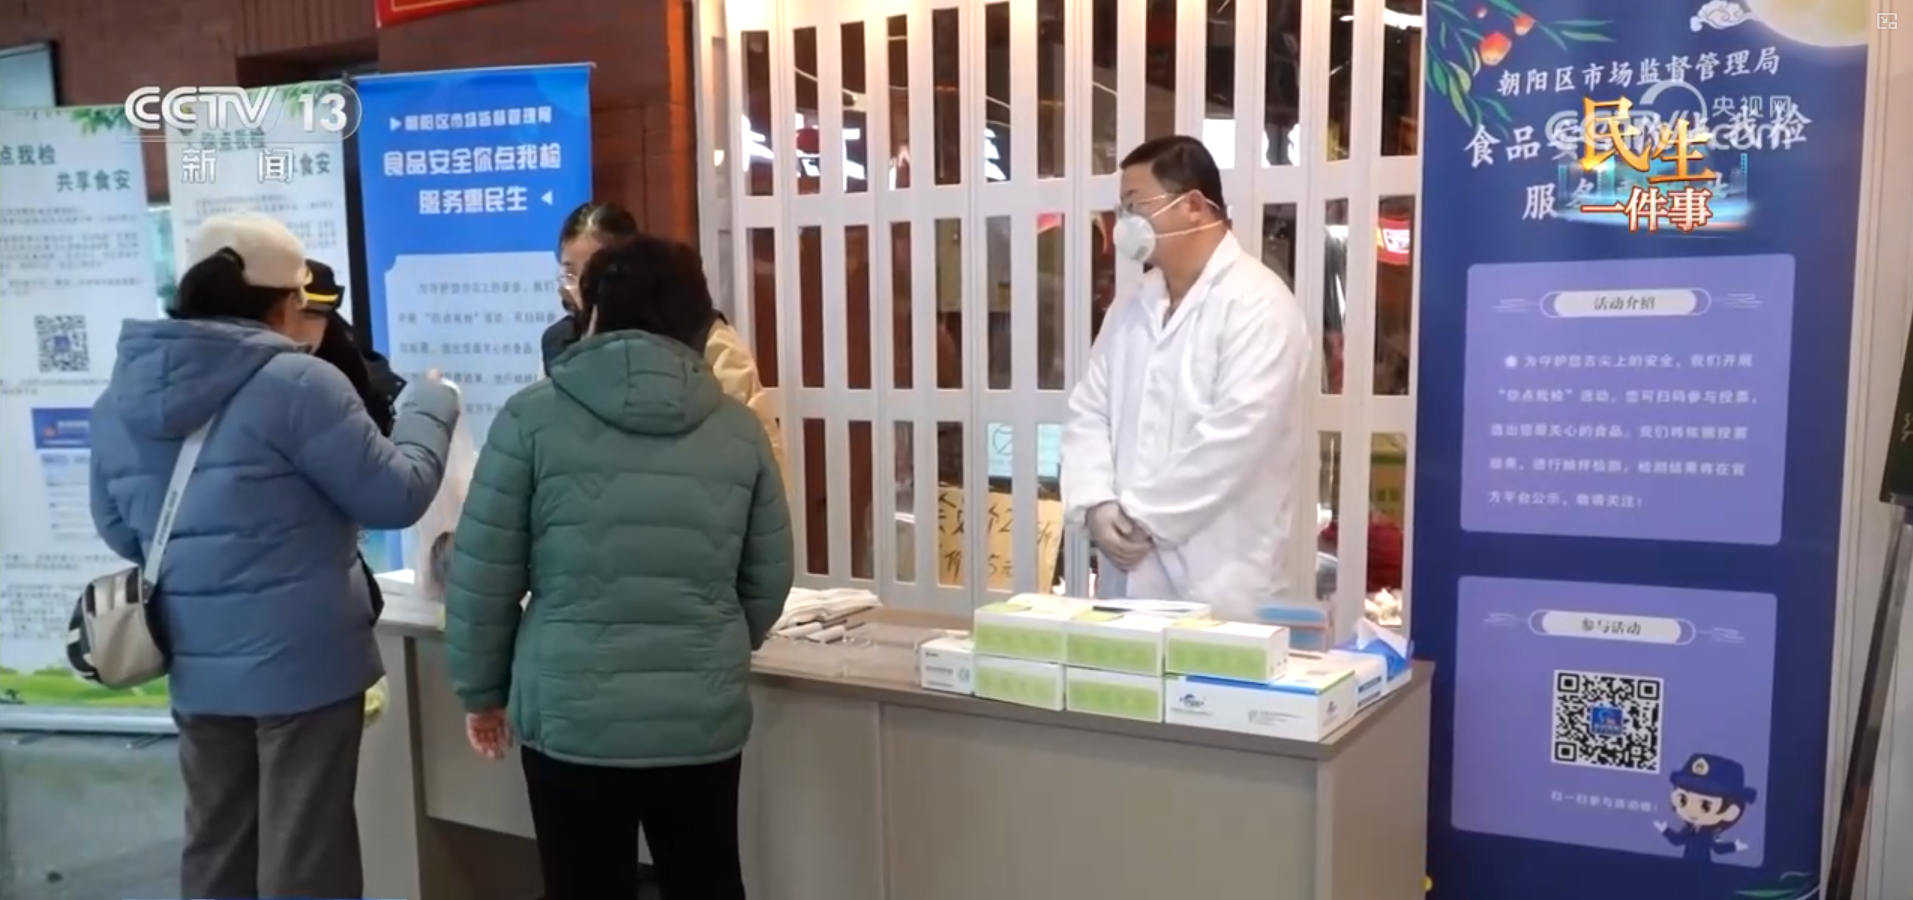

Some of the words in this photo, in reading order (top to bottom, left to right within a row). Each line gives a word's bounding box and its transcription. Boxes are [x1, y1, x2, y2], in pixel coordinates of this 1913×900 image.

[1497, 46, 1781, 97] 朝阳区市场监督管理局
[384, 143, 561, 177] 食品安全你点我检
[57, 169, 131, 192] 共享食安
[419, 186, 527, 214] 服务惠民生
[1594, 295, 1655, 311] 活动介绍
[1582, 617, 1641, 636] 参与活动
